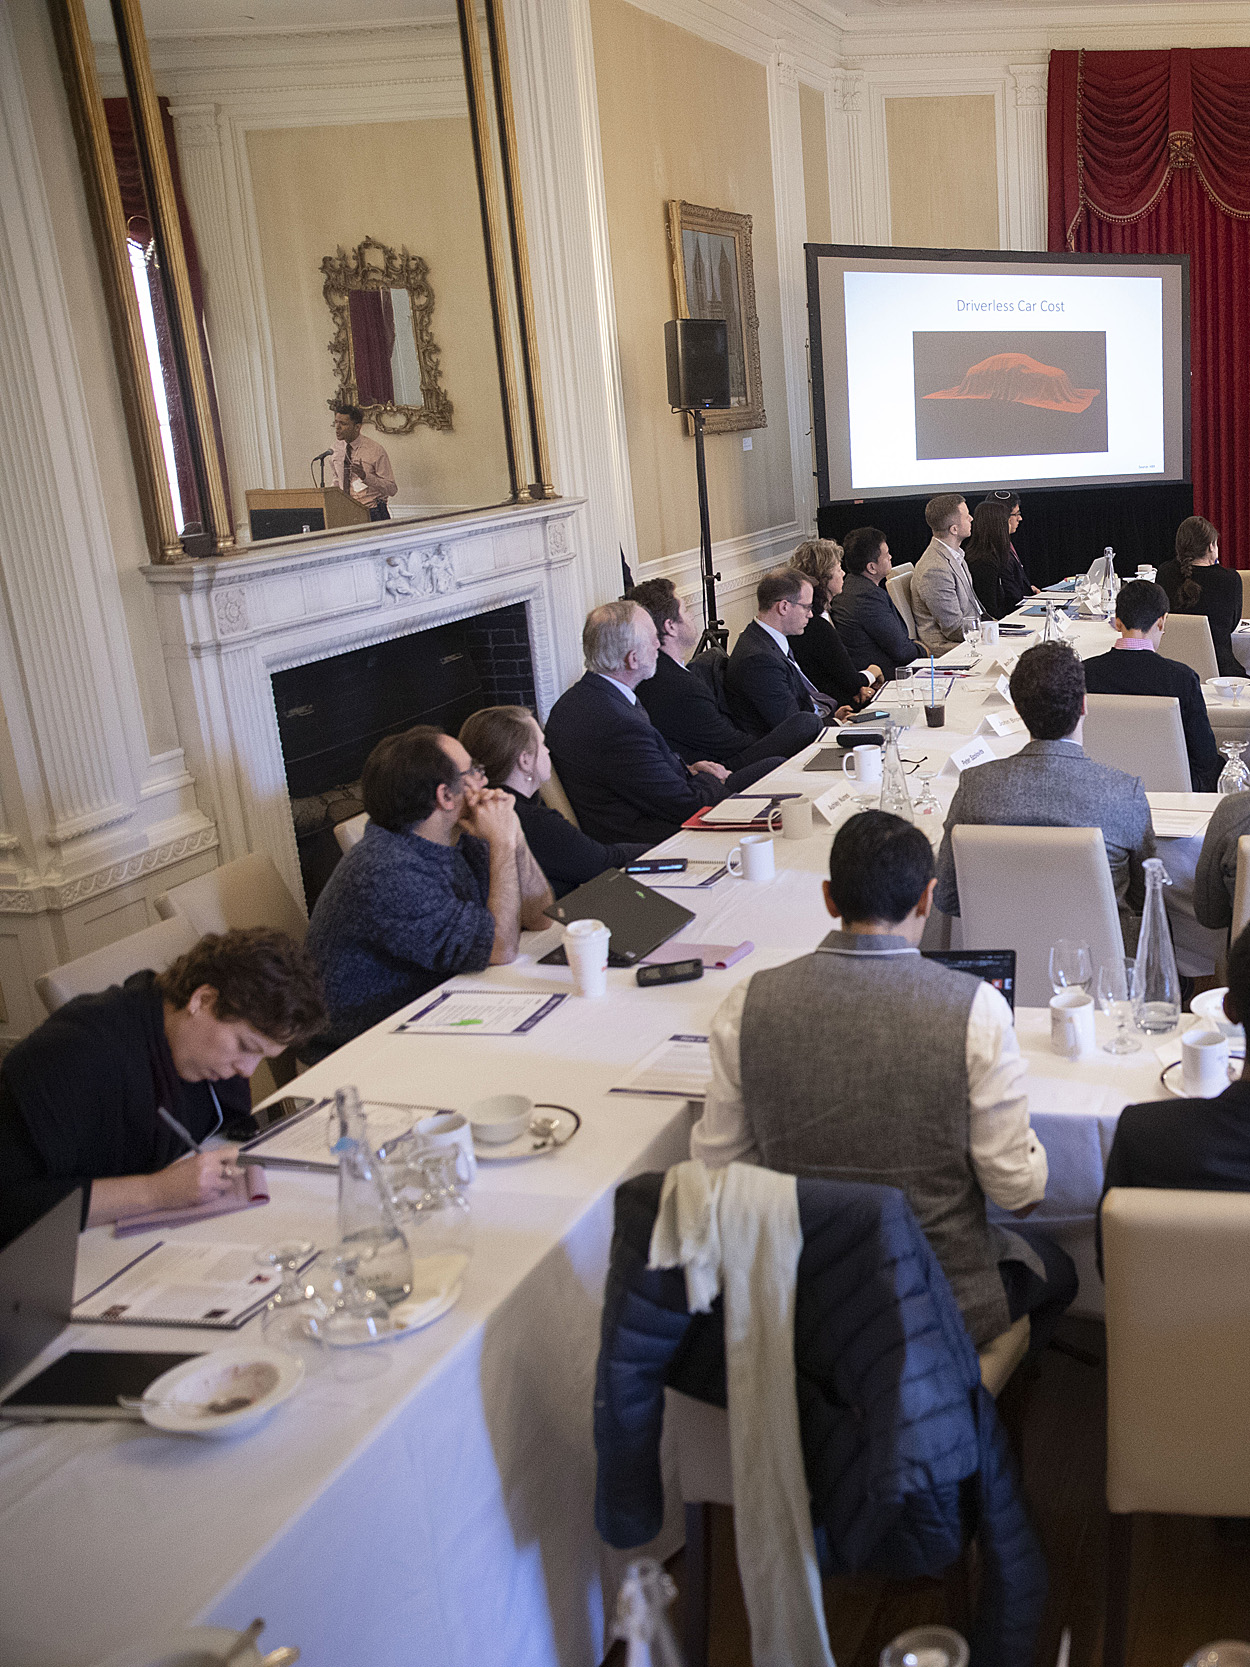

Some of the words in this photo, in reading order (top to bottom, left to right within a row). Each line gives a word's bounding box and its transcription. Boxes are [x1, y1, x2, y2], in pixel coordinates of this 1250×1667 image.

[957, 299, 1015, 312] Driverless
[1017, 299, 1037, 312] Car
[1040, 299, 1065, 312] Cost
[998, 718, 1010, 727] John
